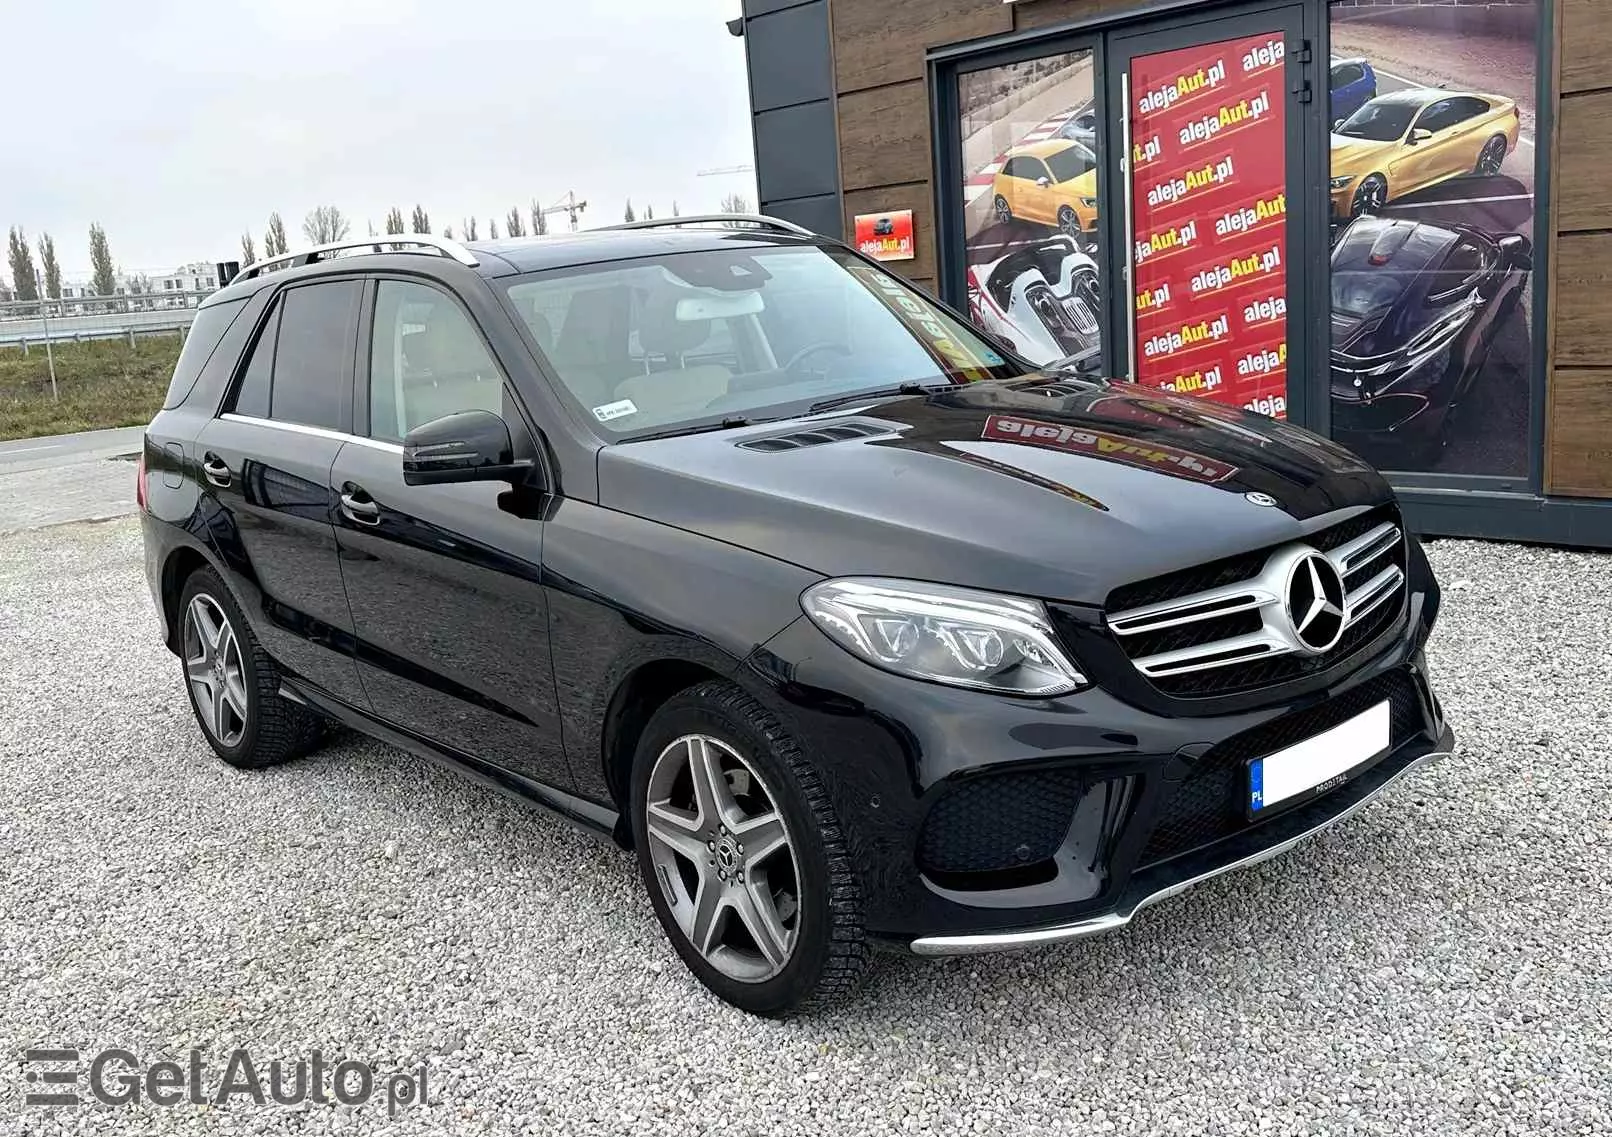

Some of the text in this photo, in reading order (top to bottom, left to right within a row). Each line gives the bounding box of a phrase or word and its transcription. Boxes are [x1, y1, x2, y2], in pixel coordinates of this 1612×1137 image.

[1242, 40, 1285, 71] aleja
[1138, 59, 1225, 114] alejaAut.pl
[1179, 91, 1270, 145] alejaAut.pl
[1147, 156, 1234, 206] alejaAut.pl
[1215, 194, 1286, 236] alejaAut
[860, 236, 910, 253] alejaAut.pl
[1135, 220, 1197, 264] jaAut.pl
[1191, 246, 1280, 292] alejaAut.pl
[1244, 297, 1287, 323] aleja
[1144, 315, 1229, 356] alejaAut.pl
[1252, 791, 1262, 803] PL
